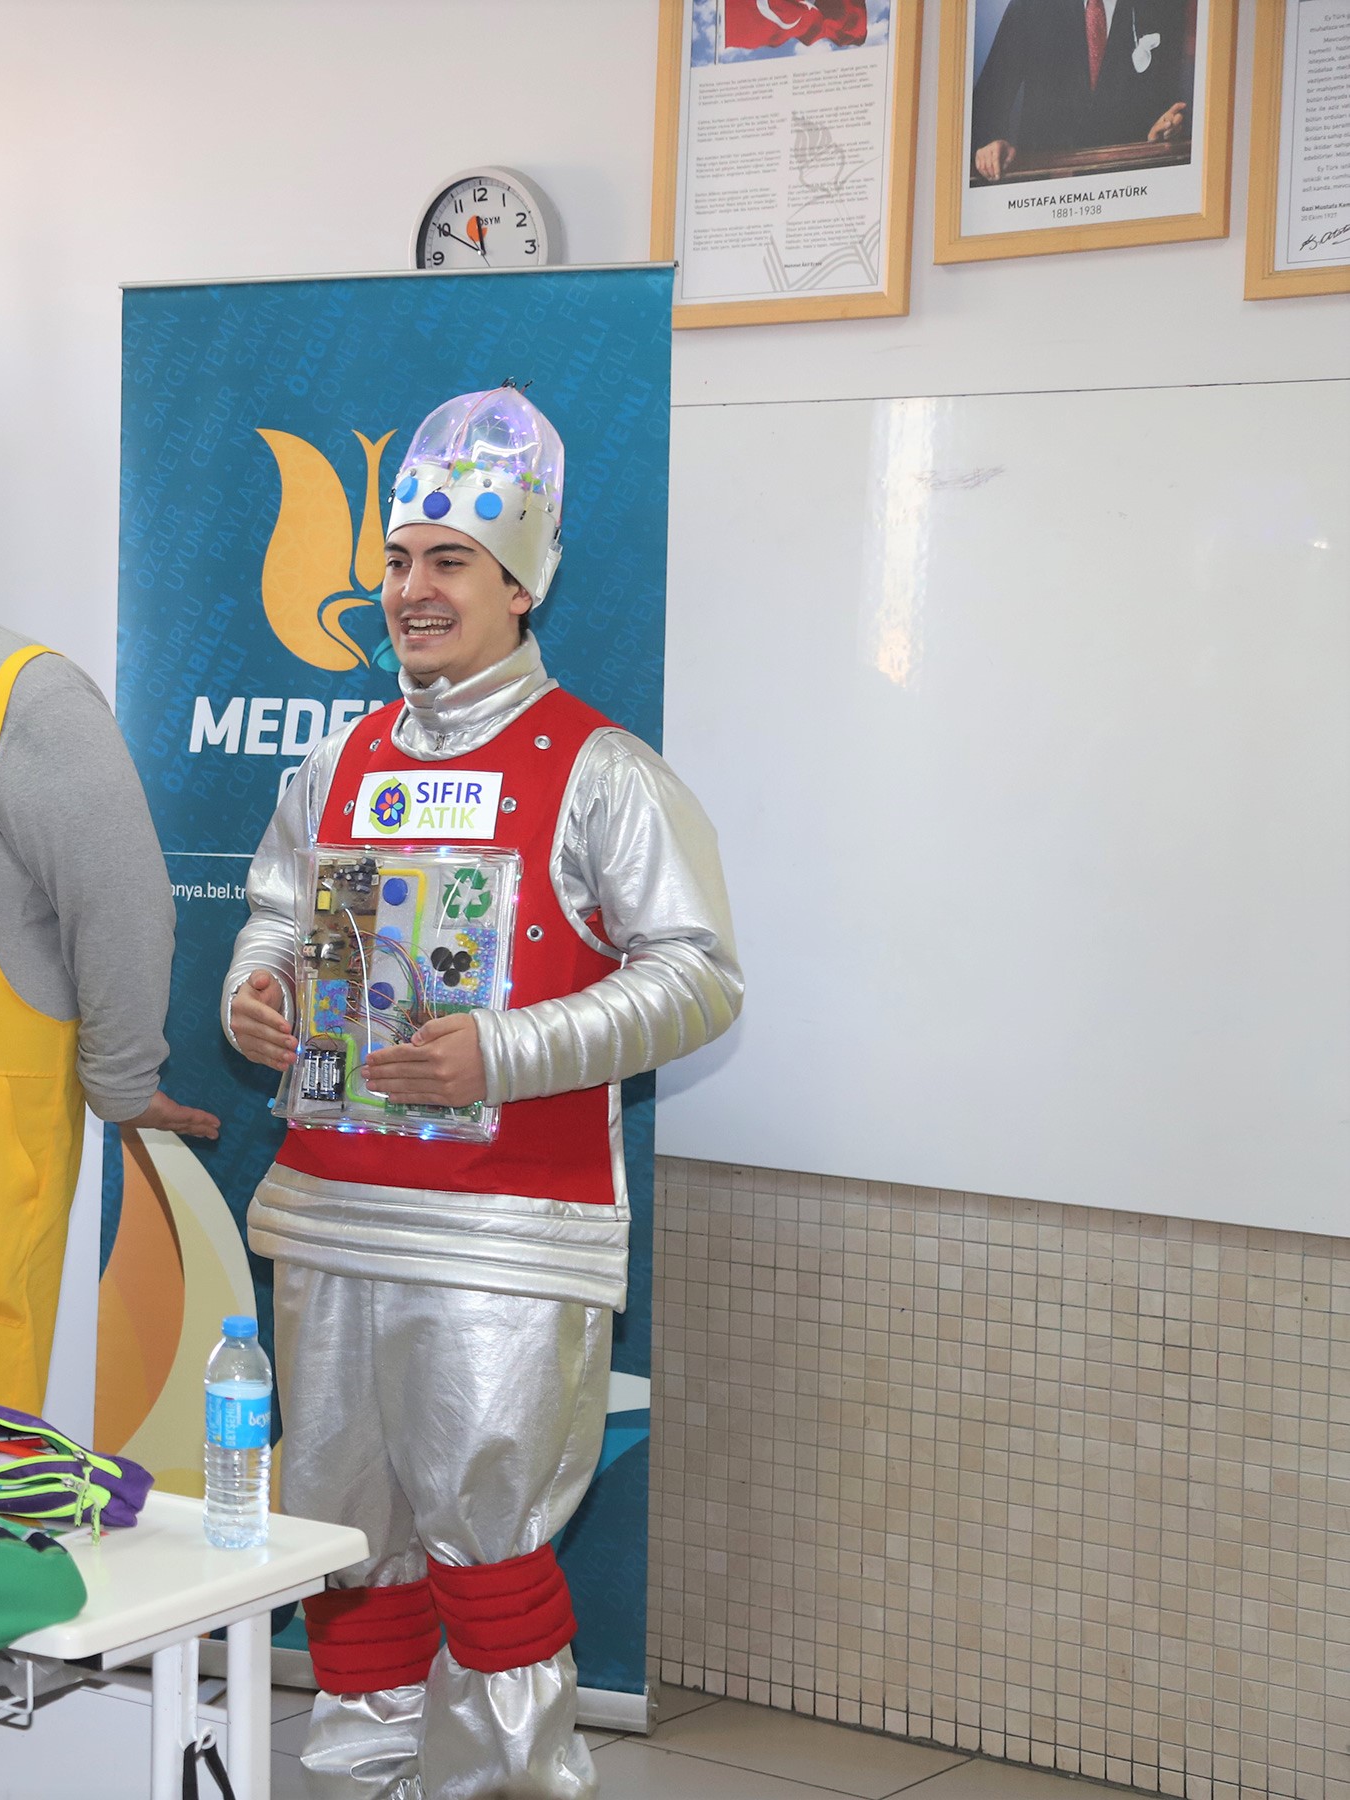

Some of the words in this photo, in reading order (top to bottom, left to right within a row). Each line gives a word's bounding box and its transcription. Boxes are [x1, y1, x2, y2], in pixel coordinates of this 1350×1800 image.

[473, 187, 489, 203] 12
[502, 193, 506, 208] 1
[1008, 195, 1057, 210] MUSTAFA
[1059, 192, 1096, 204] KEMAL
[1098, 185, 1148, 200] ATATÜRK
[454, 199, 464, 214] 11
[1052, 204, 1103, 219] 1881-1938
[515, 212, 528, 228] 2
[437, 222, 451, 238] 10
[524, 238, 537, 255] 3
[432, 251, 445, 266] 9
[188, 695, 387, 757] MEDE
[416, 781, 483, 804] SIFIR
[416, 807, 478, 829] ATIK
